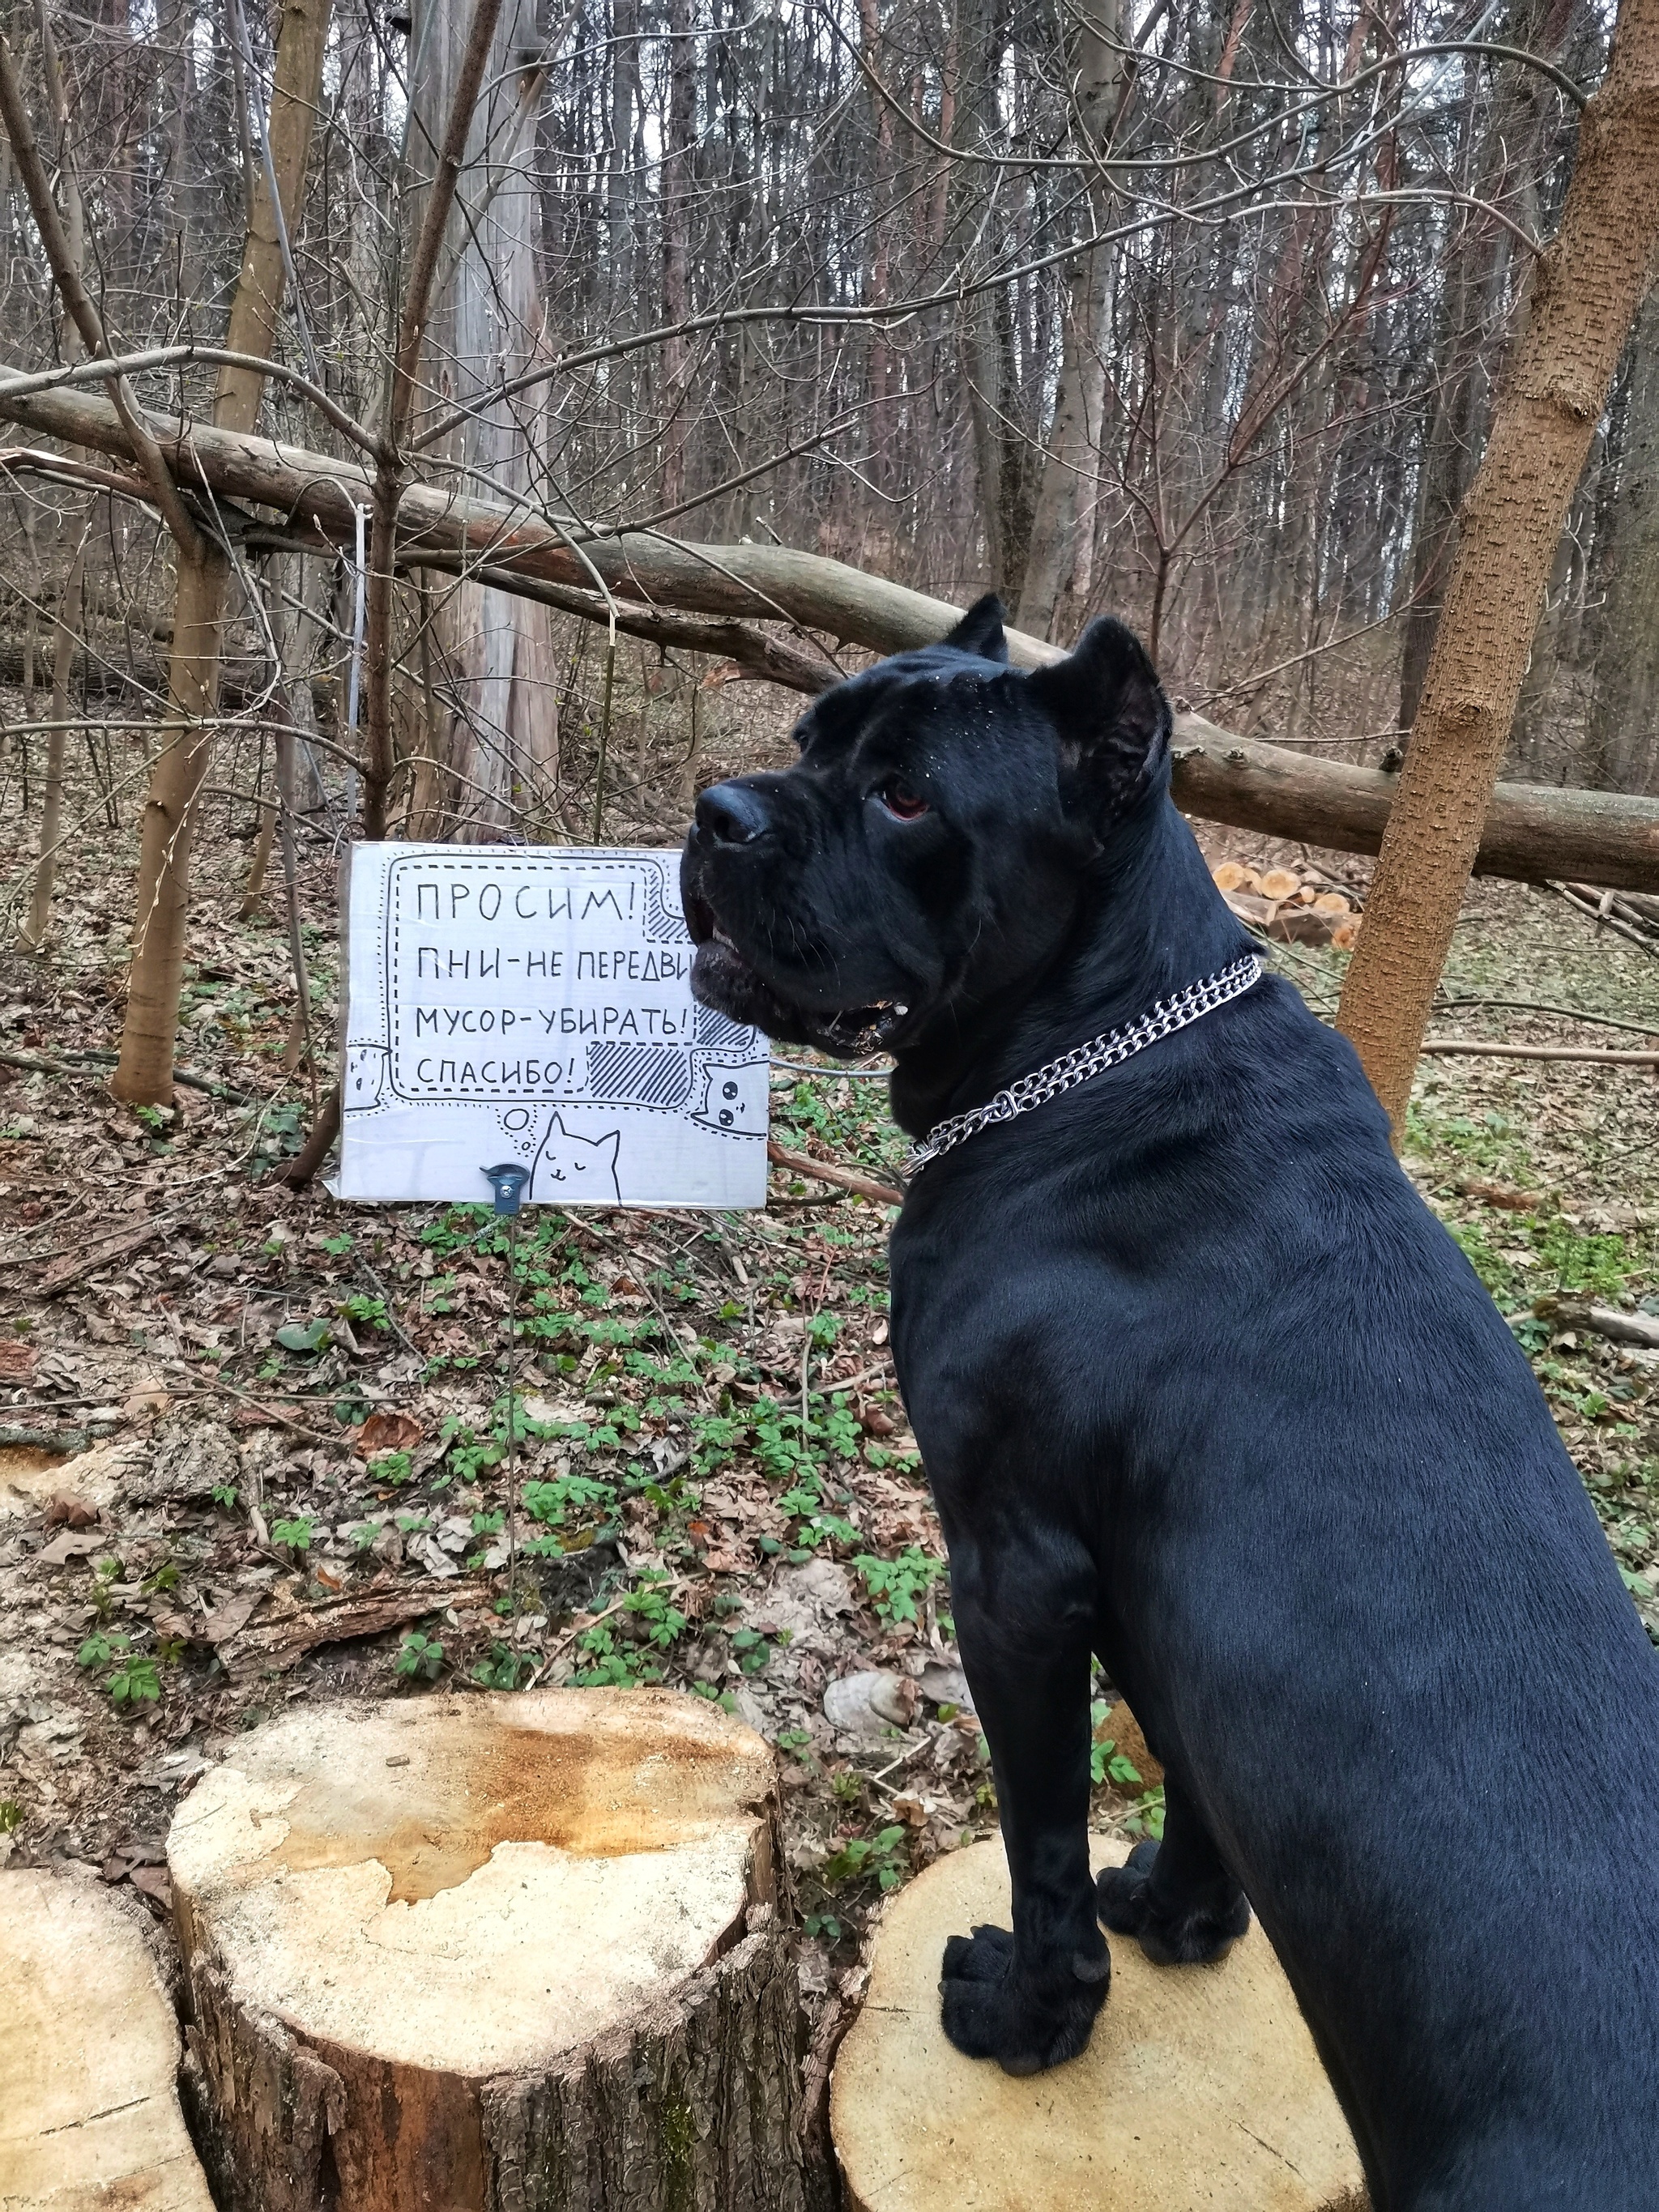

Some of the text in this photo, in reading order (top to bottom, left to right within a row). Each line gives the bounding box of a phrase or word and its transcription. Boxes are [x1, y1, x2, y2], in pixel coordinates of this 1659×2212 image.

[417, 881, 635, 922] ПРОСИМ!
[417, 947, 564, 980] ПНИ-НЕ
[416, 1006, 688, 1038] МУСОР-УБИРАТЬ!
[416, 1057, 575, 1085] СПАСИБО!
